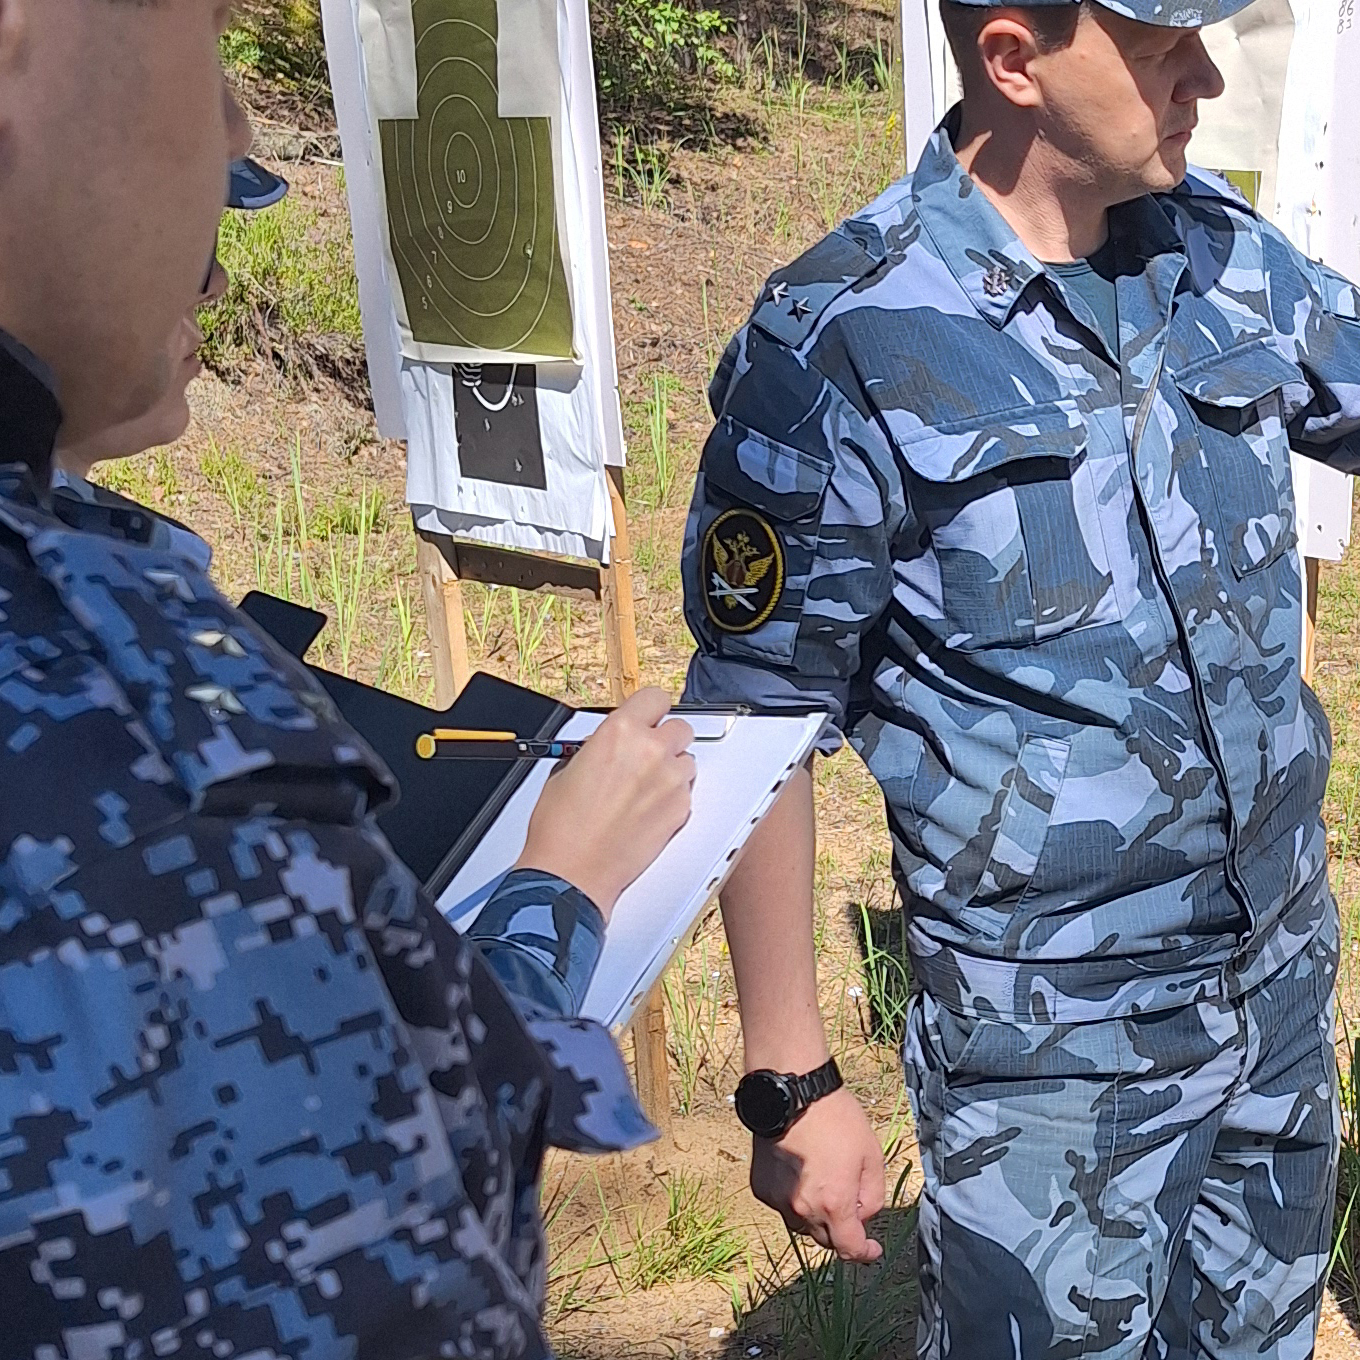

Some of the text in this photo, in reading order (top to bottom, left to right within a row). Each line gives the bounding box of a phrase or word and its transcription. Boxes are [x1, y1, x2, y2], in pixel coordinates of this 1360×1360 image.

[1338, 0, 1354, 17] 86
[456, 169, 466, 183] 10
[447, 200, 453, 214] 9
[431, 250, 437, 264] 7
[426, 274, 433, 288] 6
[421, 296, 428, 310] 5
